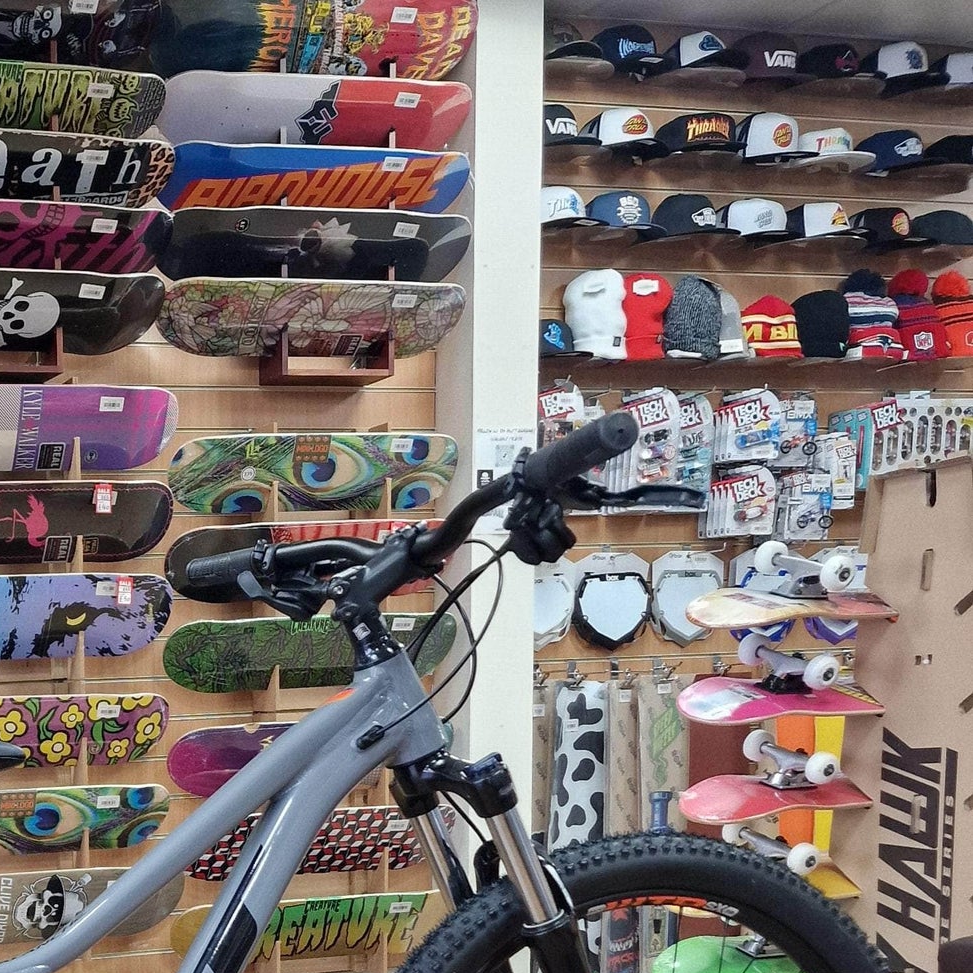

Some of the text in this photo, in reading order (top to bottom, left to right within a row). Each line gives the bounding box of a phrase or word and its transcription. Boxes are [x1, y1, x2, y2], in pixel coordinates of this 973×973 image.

[21, 389, 44, 421] KYLE
[637, 398, 663, 415] TECH
[733, 400, 761, 417] TECH
[872, 404, 897, 419] TECH
[641, 410, 670, 427] DECK
[736, 408, 770, 427] DECK
[787, 410, 814, 420] BMX
[877, 412, 901, 430] DECK
[14, 425, 39, 471] WALKER
[49, 445, 63, 469] REAL
[732, 476, 758, 493] TECH
[802, 483, 828, 493] BMX
[735, 485, 766, 503] DECK
[57, 538, 70, 561] REAL
[941, 794, 954, 898] SERIES
[257, 892, 427, 964] REATURE
